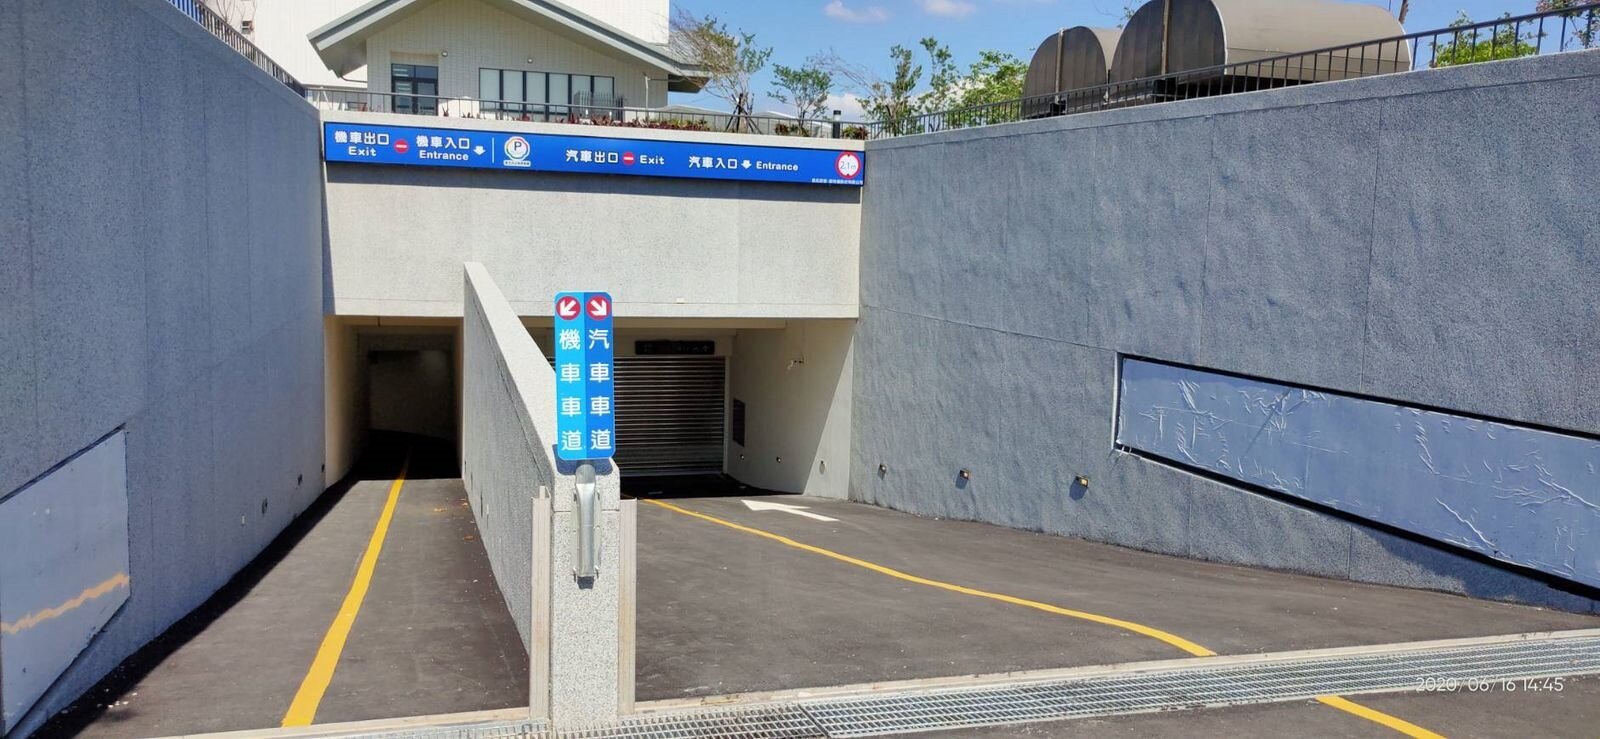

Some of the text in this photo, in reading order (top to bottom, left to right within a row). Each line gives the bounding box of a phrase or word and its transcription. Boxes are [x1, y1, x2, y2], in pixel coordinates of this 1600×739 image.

[335, 131, 390, 145] 機車出口
[416, 135, 470, 149] 機車入口
[348, 146, 377, 157] Exit
[514, 141, 522, 151] P
[419, 150, 469, 161] Entrance
[565, 150, 619, 163] 汽車出口
[638, 155, 665, 165] Exit
[688, 156, 738, 170] 汽車入口
[756, 161, 799, 171] Entrance
[559, 329, 582, 451] 機車車道
[588, 329, 611, 450] 汽車車道
